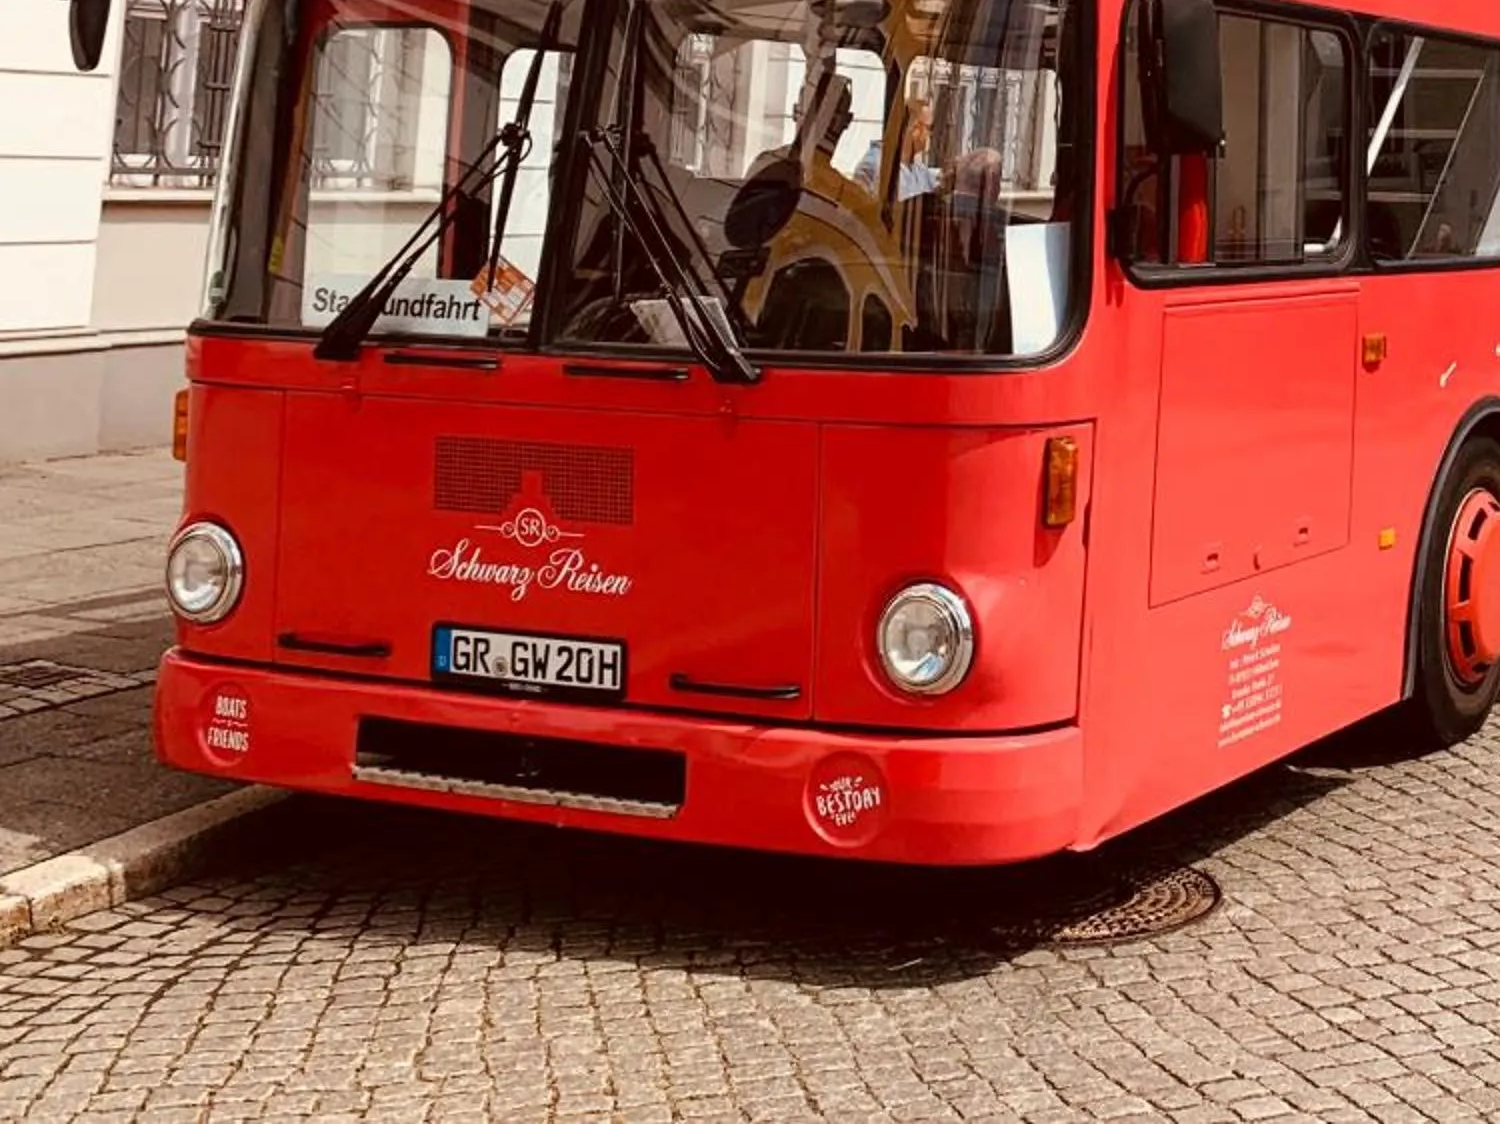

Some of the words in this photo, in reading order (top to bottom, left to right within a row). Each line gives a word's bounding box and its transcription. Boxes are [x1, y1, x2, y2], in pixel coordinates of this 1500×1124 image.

[312, 287, 481, 321] Staundfahrt
[520, 517, 541, 536] SR
[427, 538, 534, 602] Schwarz
[537, 547, 632, 596] Reisen
[216, 695, 248, 719] BOATS
[208, 726, 249, 752] FRIENDS
